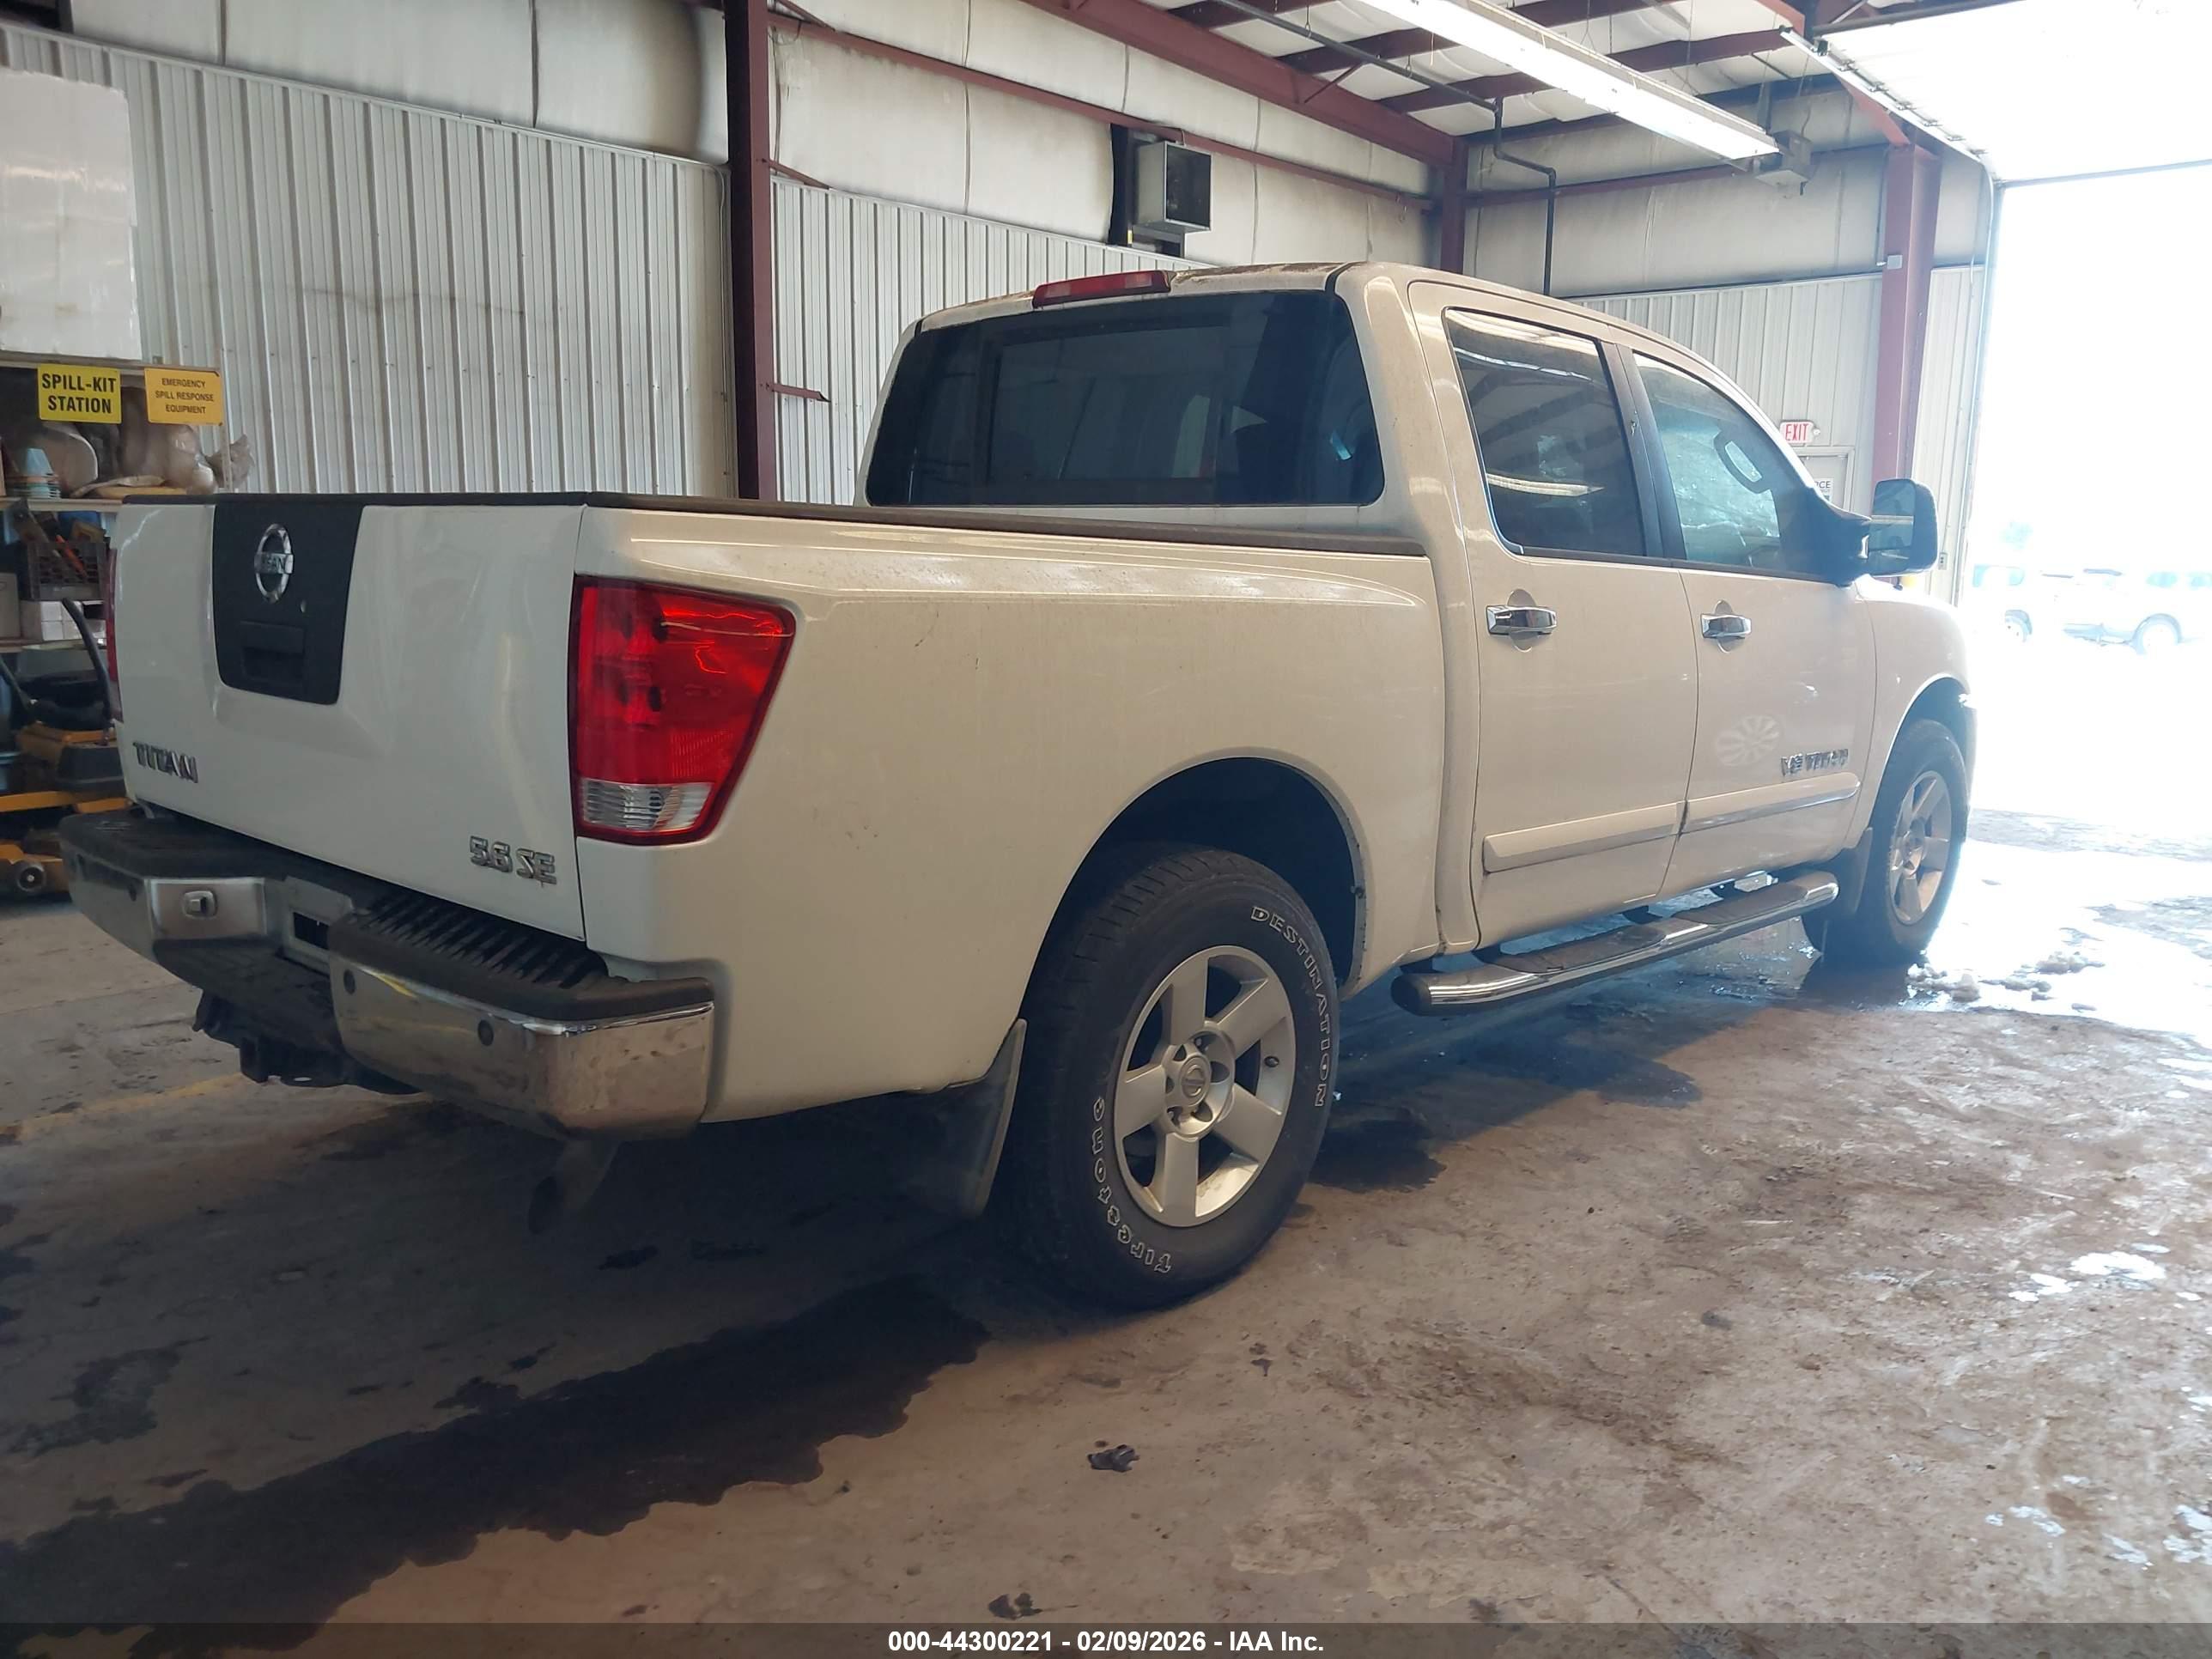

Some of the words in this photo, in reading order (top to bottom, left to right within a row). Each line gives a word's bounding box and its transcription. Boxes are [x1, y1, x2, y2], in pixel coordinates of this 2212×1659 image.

[41, 373, 117, 393] SPILL-KIT
[161, 378, 206, 388] EMERGENCY
[48, 395, 112, 414] STATION
[155, 390, 174, 400] SPILL
[176, 392, 214, 403] RESPONSE
[166, 404, 206, 414] EQUIPMENT
[1785, 422, 1808, 441] EXIT
[132, 742, 198, 784] TITAN
[516, 848, 557, 884] SE
[1250, 907, 1331, 1108] DESTINATION
